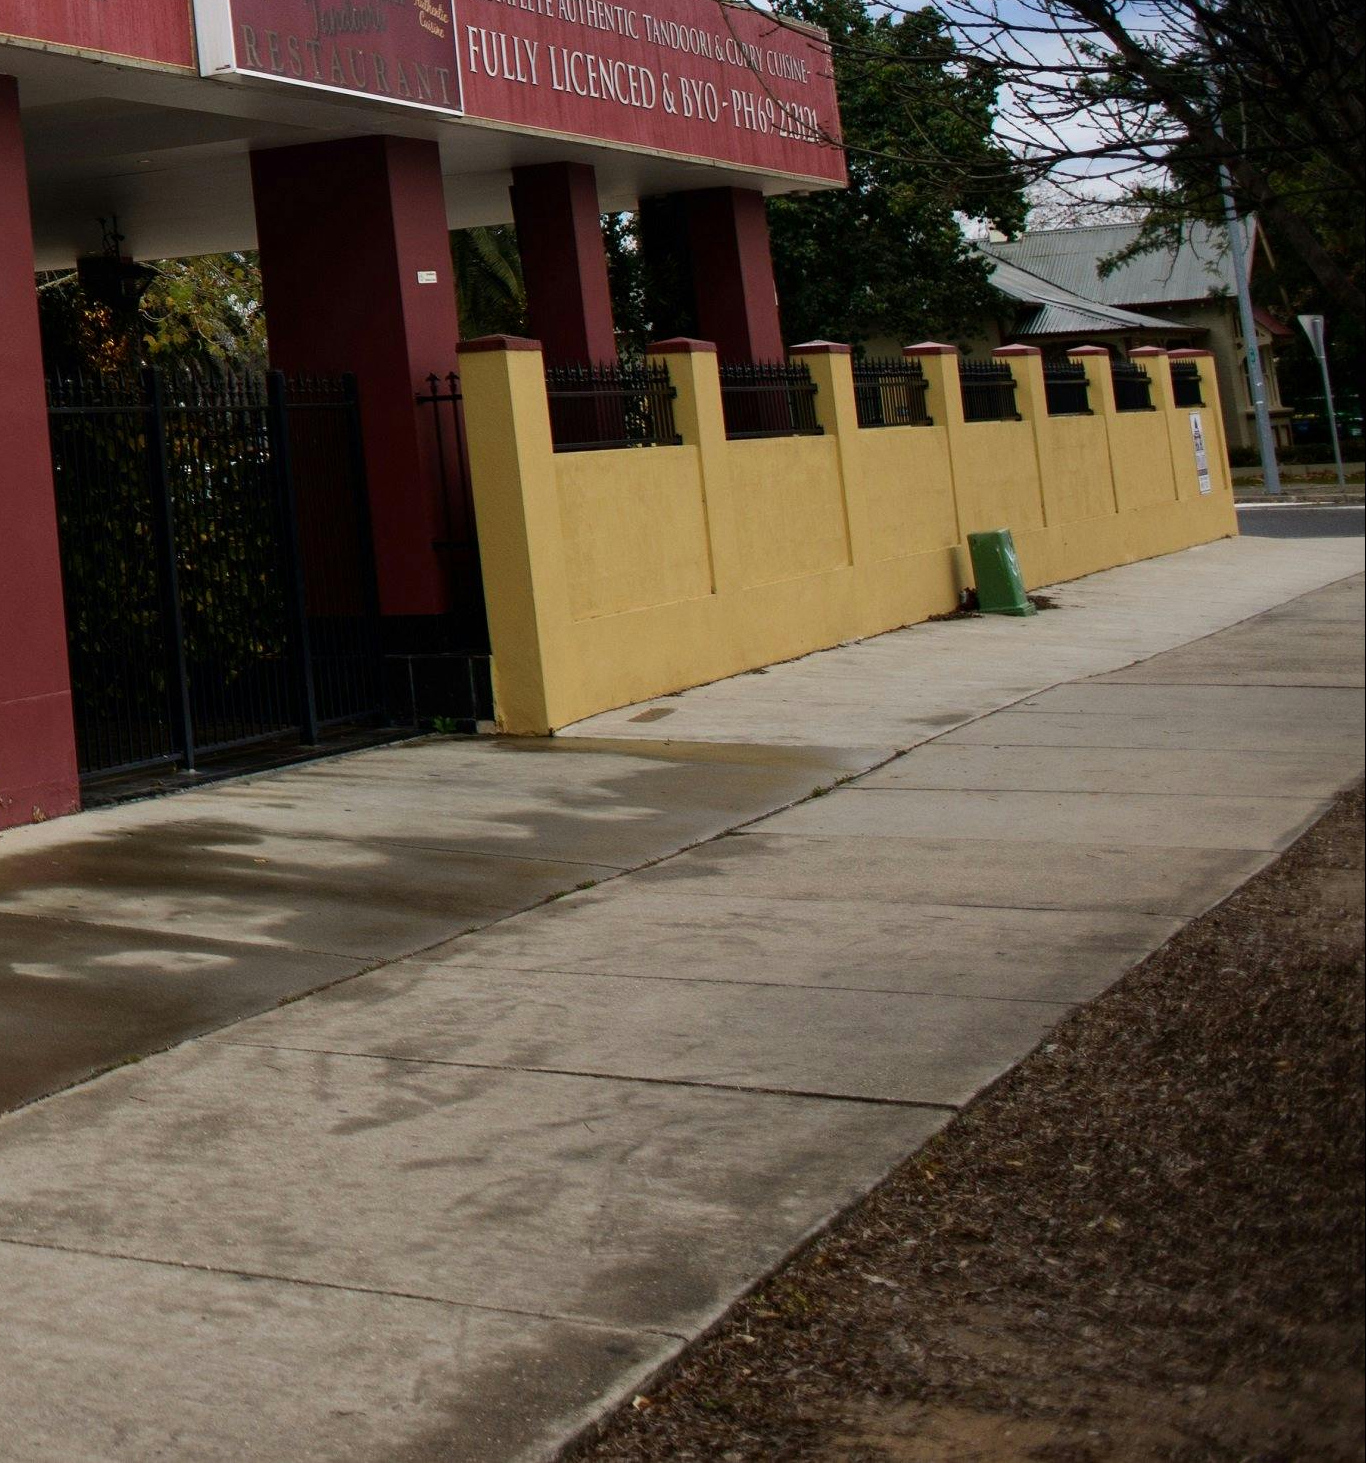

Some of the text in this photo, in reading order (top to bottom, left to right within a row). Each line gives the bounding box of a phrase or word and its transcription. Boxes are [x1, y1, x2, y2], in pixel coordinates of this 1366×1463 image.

[418, 13, 446, 40] Cuisine
[643, 14, 712, 59] TANDOORI
[714, 34, 725, 61] &
[725, 38, 764, 73] CURRY
[240, 24, 452, 106] RESTAURANT
[466, 25, 539, 86] FULLY
[548, 45, 656, 110] LICENCED
[662, 72, 678, 115] &
[679, 76, 719, 123] BYO
